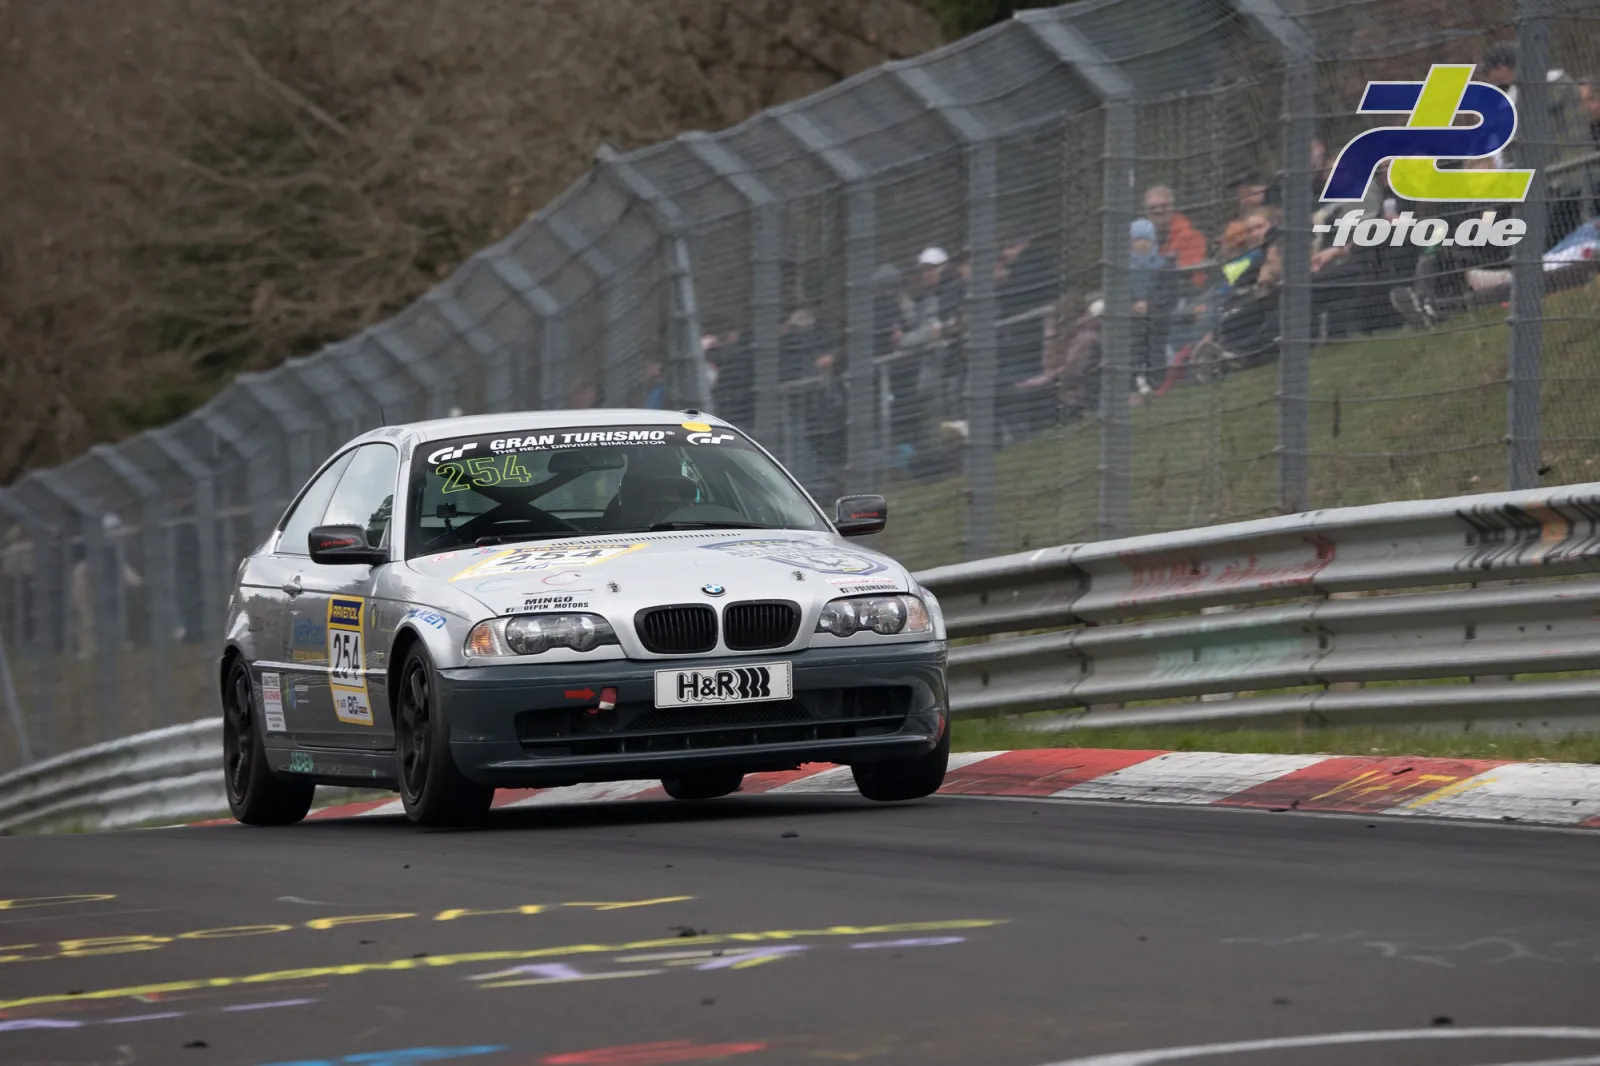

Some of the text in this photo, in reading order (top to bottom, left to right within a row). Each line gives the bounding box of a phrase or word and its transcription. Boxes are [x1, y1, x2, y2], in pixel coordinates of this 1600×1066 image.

[489, 435, 555, 450] GRAN
[550, 441, 598, 449] DRIVING
[435, 455, 532, 494] 254
[496, 549, 603, 566] 254
[524, 596, 573, 605] MINGO
[333, 632, 361, 680] 254
[677, 670, 740, 702] H&R
